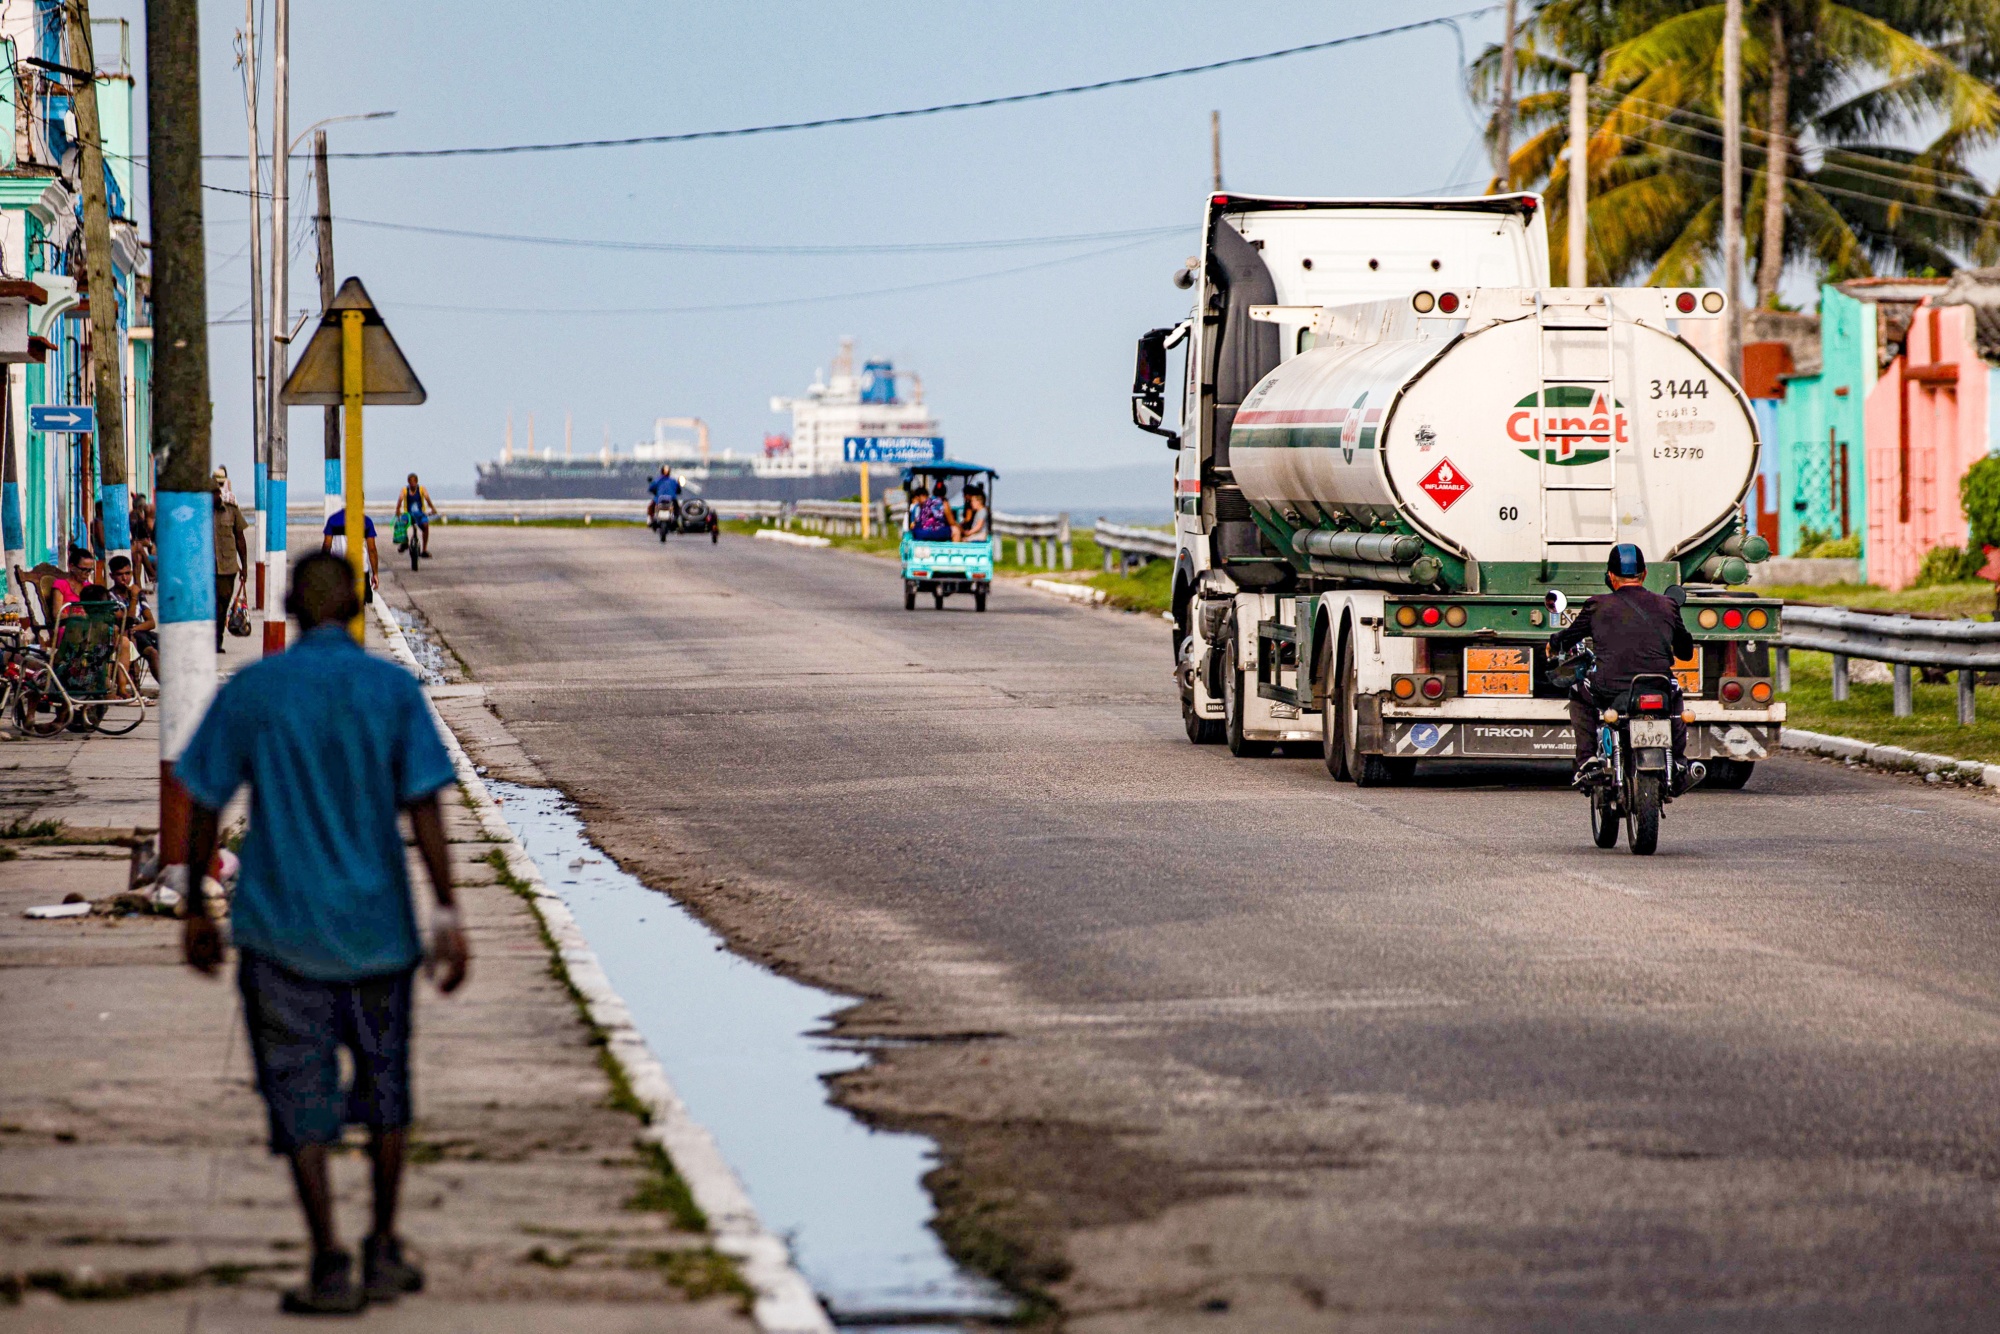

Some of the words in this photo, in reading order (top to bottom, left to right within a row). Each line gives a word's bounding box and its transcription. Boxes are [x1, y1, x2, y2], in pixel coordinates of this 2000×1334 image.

[1424, 483, 1465, 491] INFLAMABLE
[1499, 507, 1518, 521] 60
[1474, 727, 1534, 738] TIRKON
